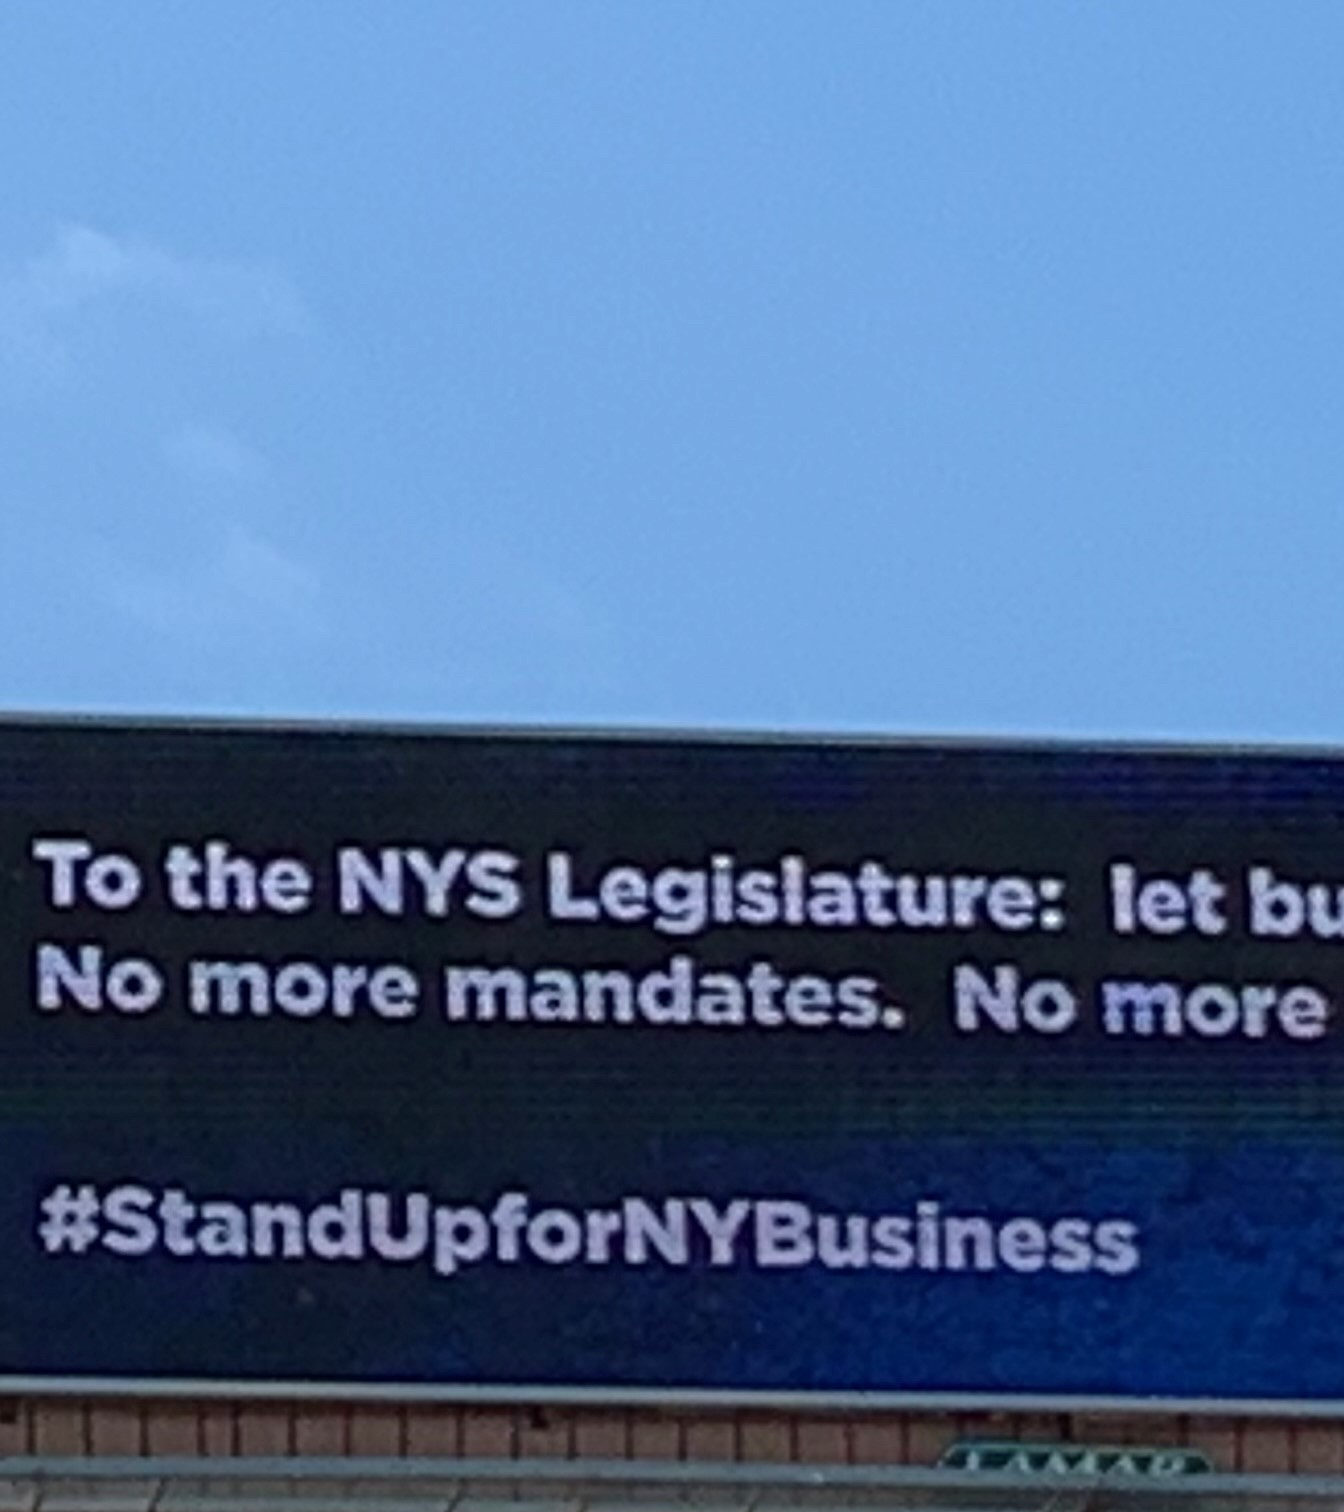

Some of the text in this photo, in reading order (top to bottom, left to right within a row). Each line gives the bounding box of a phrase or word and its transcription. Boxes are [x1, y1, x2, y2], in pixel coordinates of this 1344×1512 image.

[32, 840, 141, 908] To
[165, 842, 312, 912] the
[339, 848, 521, 917] NYS
[548, 853, 1064, 934] Legislature:
[1111, 863, 1226, 935] let
[36, 944, 162, 1012] No
[190, 961, 418, 1018] more
[446, 956, 904, 1028] mandates.
[954, 965, 1076, 1031] No
[1103, 983, 1327, 1038] more
[38, 1185, 1138, 1275] #StandUpforNYBusiness
